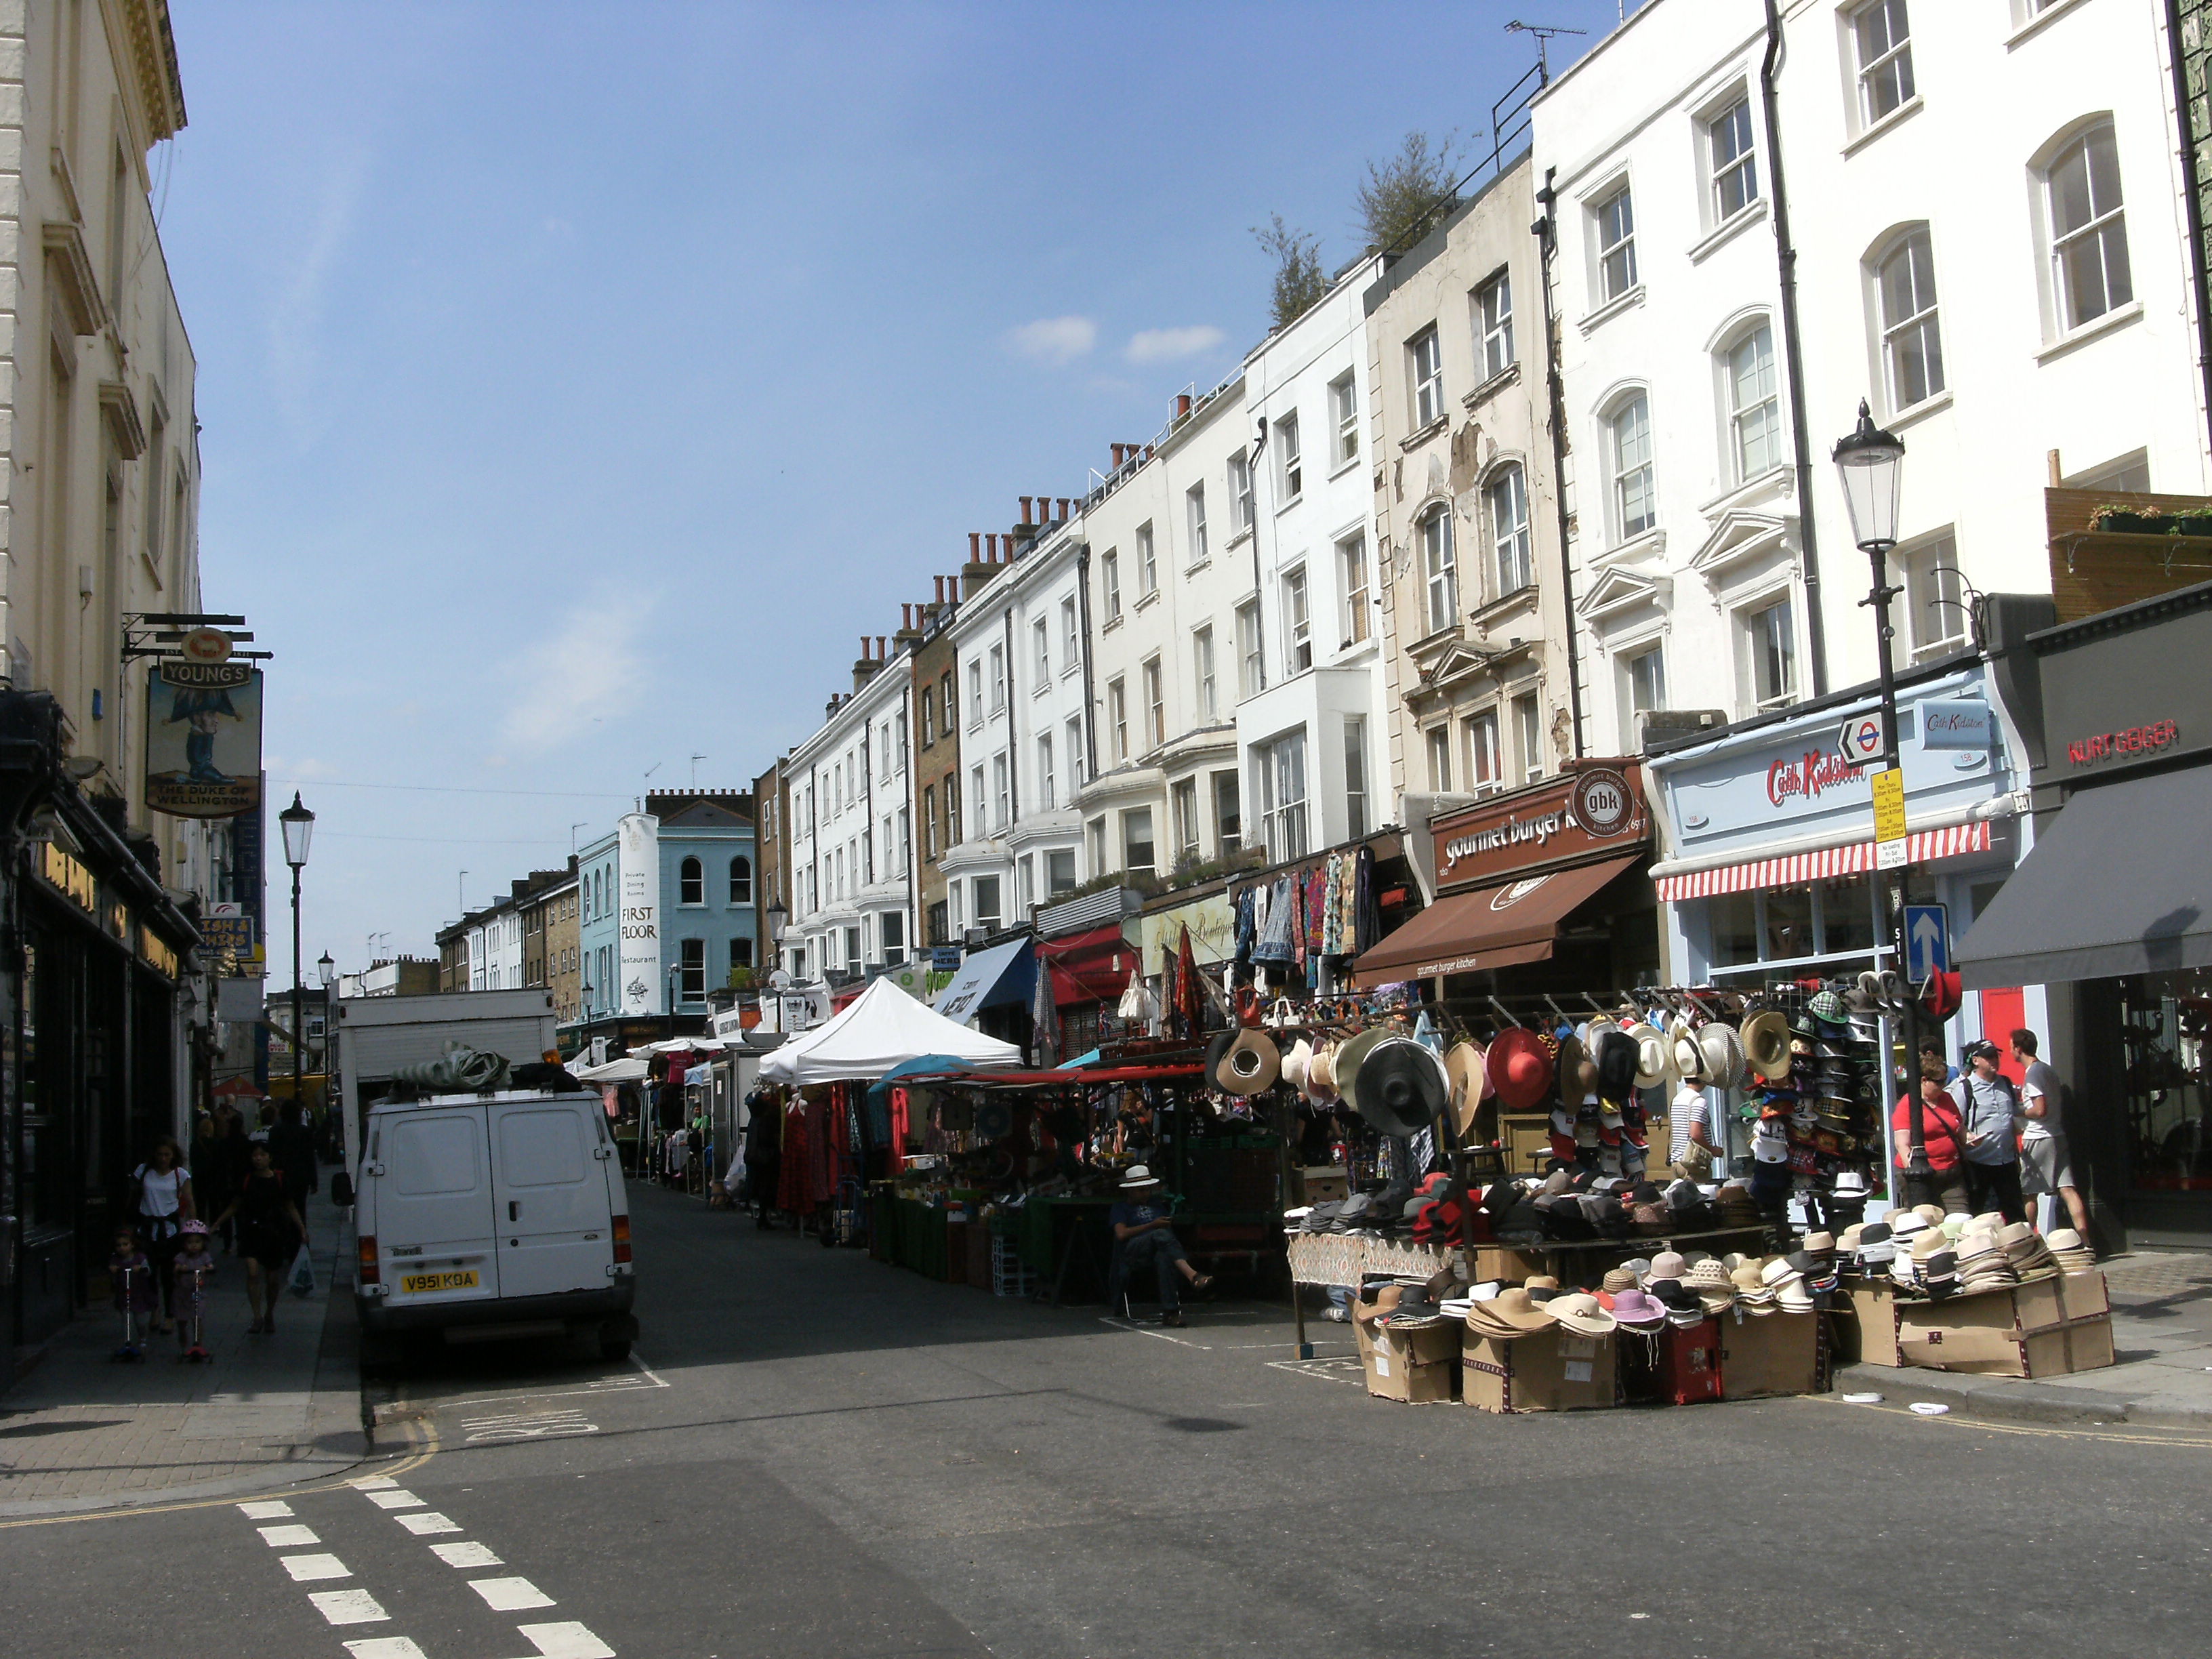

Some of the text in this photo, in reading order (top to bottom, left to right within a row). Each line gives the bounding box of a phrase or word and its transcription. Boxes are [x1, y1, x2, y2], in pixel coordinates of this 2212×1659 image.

[169, 666, 244, 682] YOUNG'S
[1927, 714, 1984, 731] Cath Kidston
[2068, 718, 2177, 763] KURT GEIGER
[1961, 753, 1972, 762] 158
[1580, 773, 1626, 793] gourmet burger
[1767, 759, 1801, 804] Cath
[158, 786, 249, 795] THE DUKE OF
[157, 796, 249, 805] WELLINGTON
[1589, 791, 1618, 813] gbk
[1593, 823, 1620, 832] kitchen
[1446, 821, 1507, 867] gourmet
[1510, 811, 1562, 844] burger
[622, 907, 653, 921] FIRST
[202, 919, 233, 933] ISH
[622, 925, 657, 939] FLOOR
[1417, 958, 1476, 978] gourmet burger kitchen
[407, 1272, 473, 1290] V951 KOA
